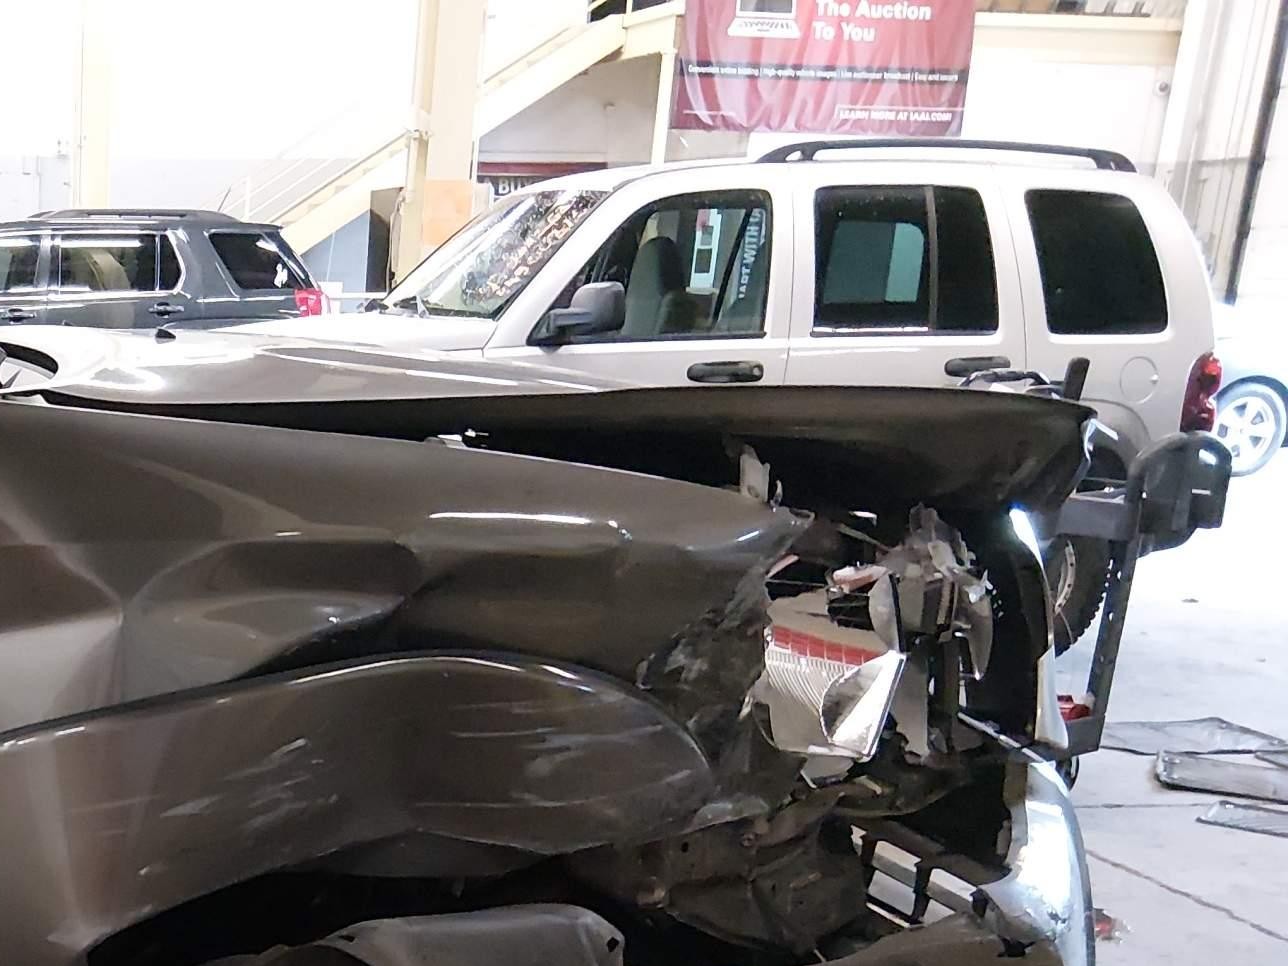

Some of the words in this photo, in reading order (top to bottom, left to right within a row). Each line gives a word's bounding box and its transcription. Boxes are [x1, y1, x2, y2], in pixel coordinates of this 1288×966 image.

[816, 0, 851, 17] The
[855, 0, 932, 20] Auction
[812, 20, 835, 40] To
[840, 21, 875, 41] You
[839, 109, 869, 120] LEARN
[870, 110, 896, 121] MORE
[897, 111, 908, 121] AT
[743, 225, 760, 264] WITH
